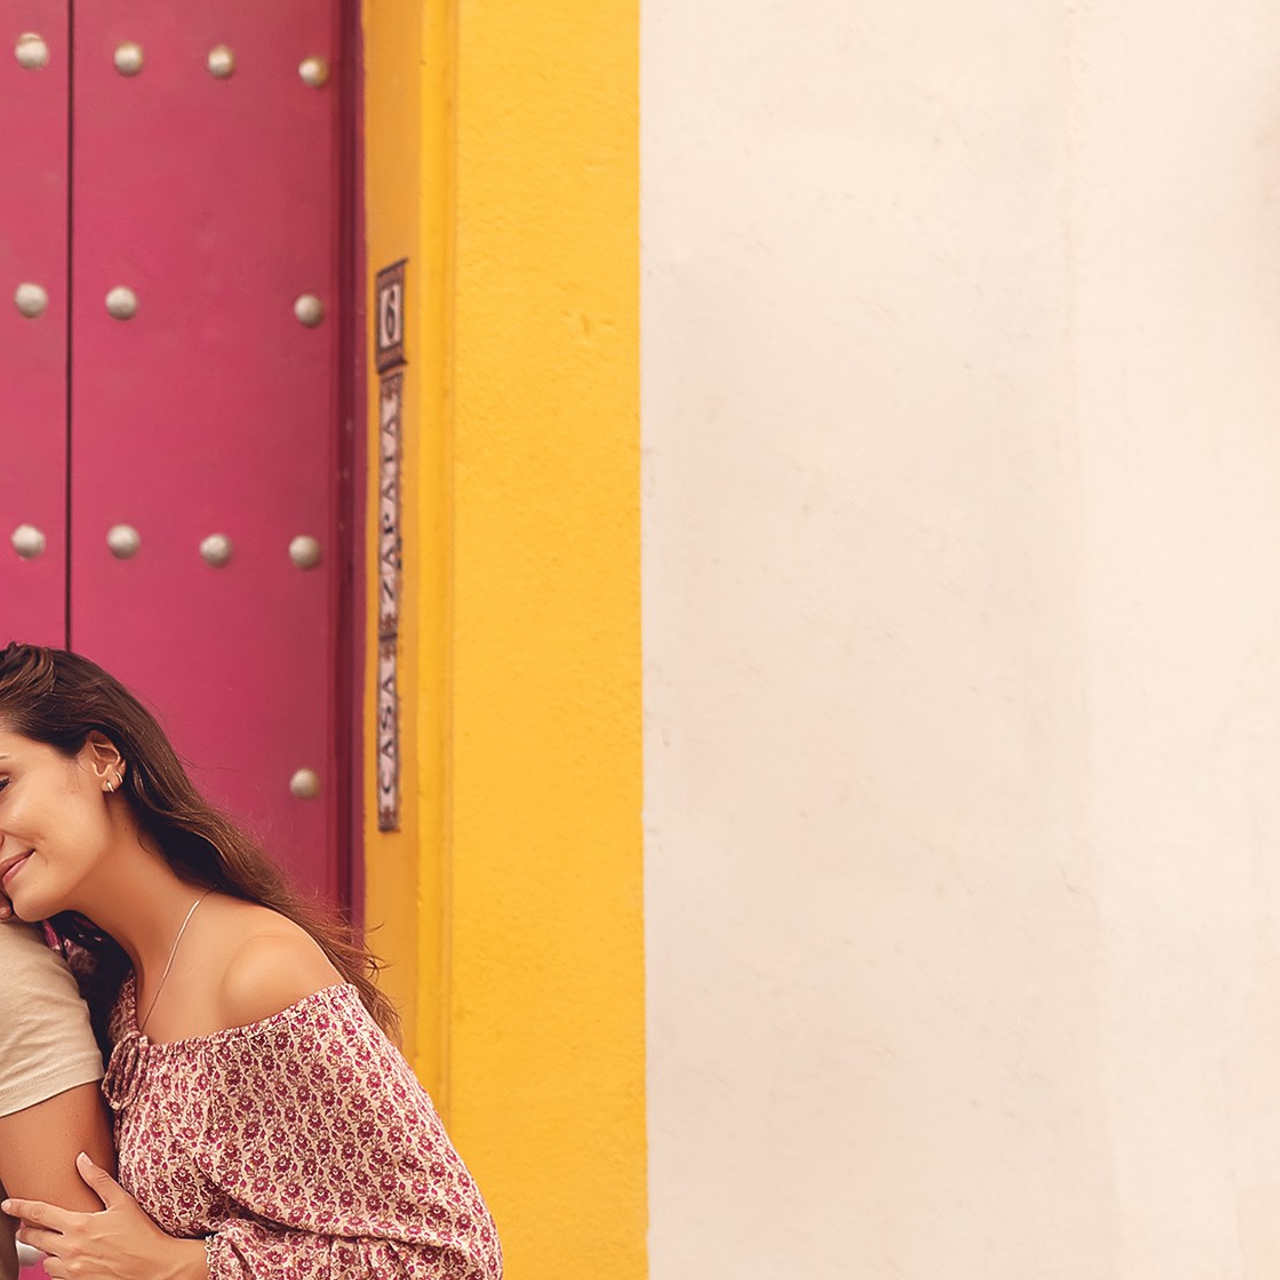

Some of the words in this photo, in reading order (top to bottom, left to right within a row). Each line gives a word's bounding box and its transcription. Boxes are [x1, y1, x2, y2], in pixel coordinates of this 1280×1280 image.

[385, 288, 396, 341] 6
[381, 416, 396, 600] ZAPATA
[381, 675, 394, 794] CASA
